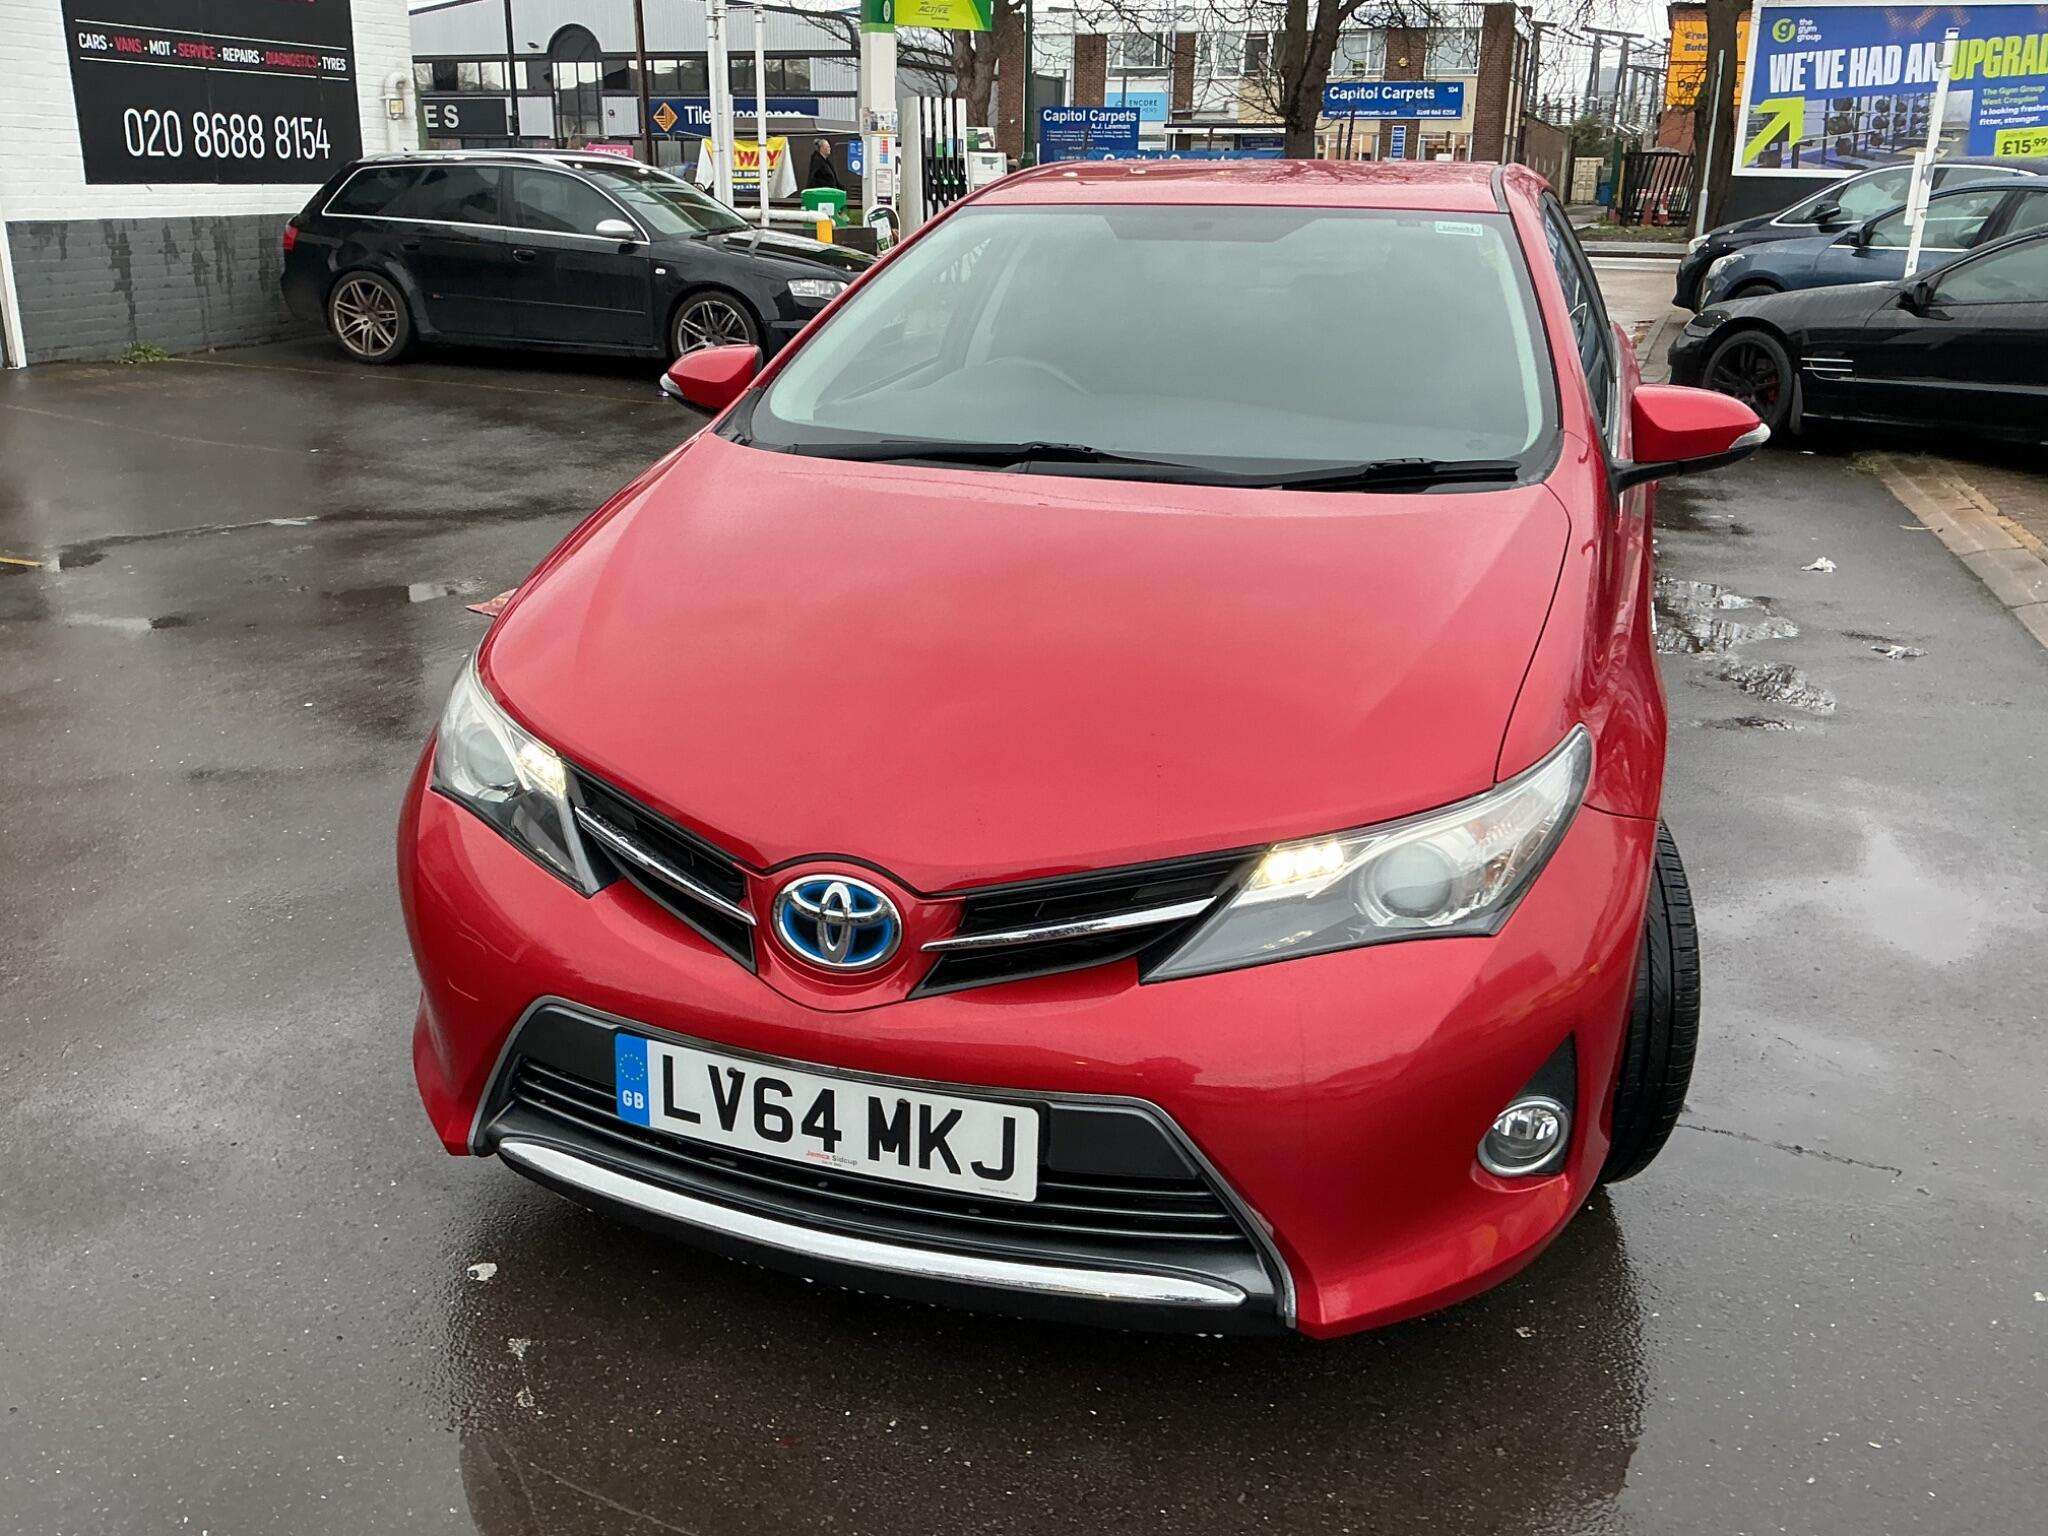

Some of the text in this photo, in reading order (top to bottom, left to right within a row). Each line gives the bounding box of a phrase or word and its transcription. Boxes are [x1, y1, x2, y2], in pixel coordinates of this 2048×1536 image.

[1799, 18, 1813, 26] the
[1798, 26, 1818, 34] gym
[1797, 34, 1822, 43] group
[79, 32, 346, 71] CARS VANS MOT SERVICE REPAIRS DIAGNOSTICS TYRES
[1769, 49, 1846, 93] WE'VE
[1848, 45, 1903, 88] HAD
[1904, 42, 1939, 84] AN
[1329, 86, 1378, 102] Capitol
[1381, 86, 1436, 102] Carpets
[1983, 88, 1998, 96] The
[684, 105, 712, 125] Tile
[1043, 109, 1137, 124] Capitol Carpets
[1988, 106, 2020, 116] looking
[1980, 115, 2041, 126] fitter, stronger.
[124, 108, 331, 160] 020 8688 8154
[623, 1089, 644, 1110] GB
[662, 1054, 1016, 1181] LV64 MKJ
[831, 1154, 858, 1167] Sidcup
